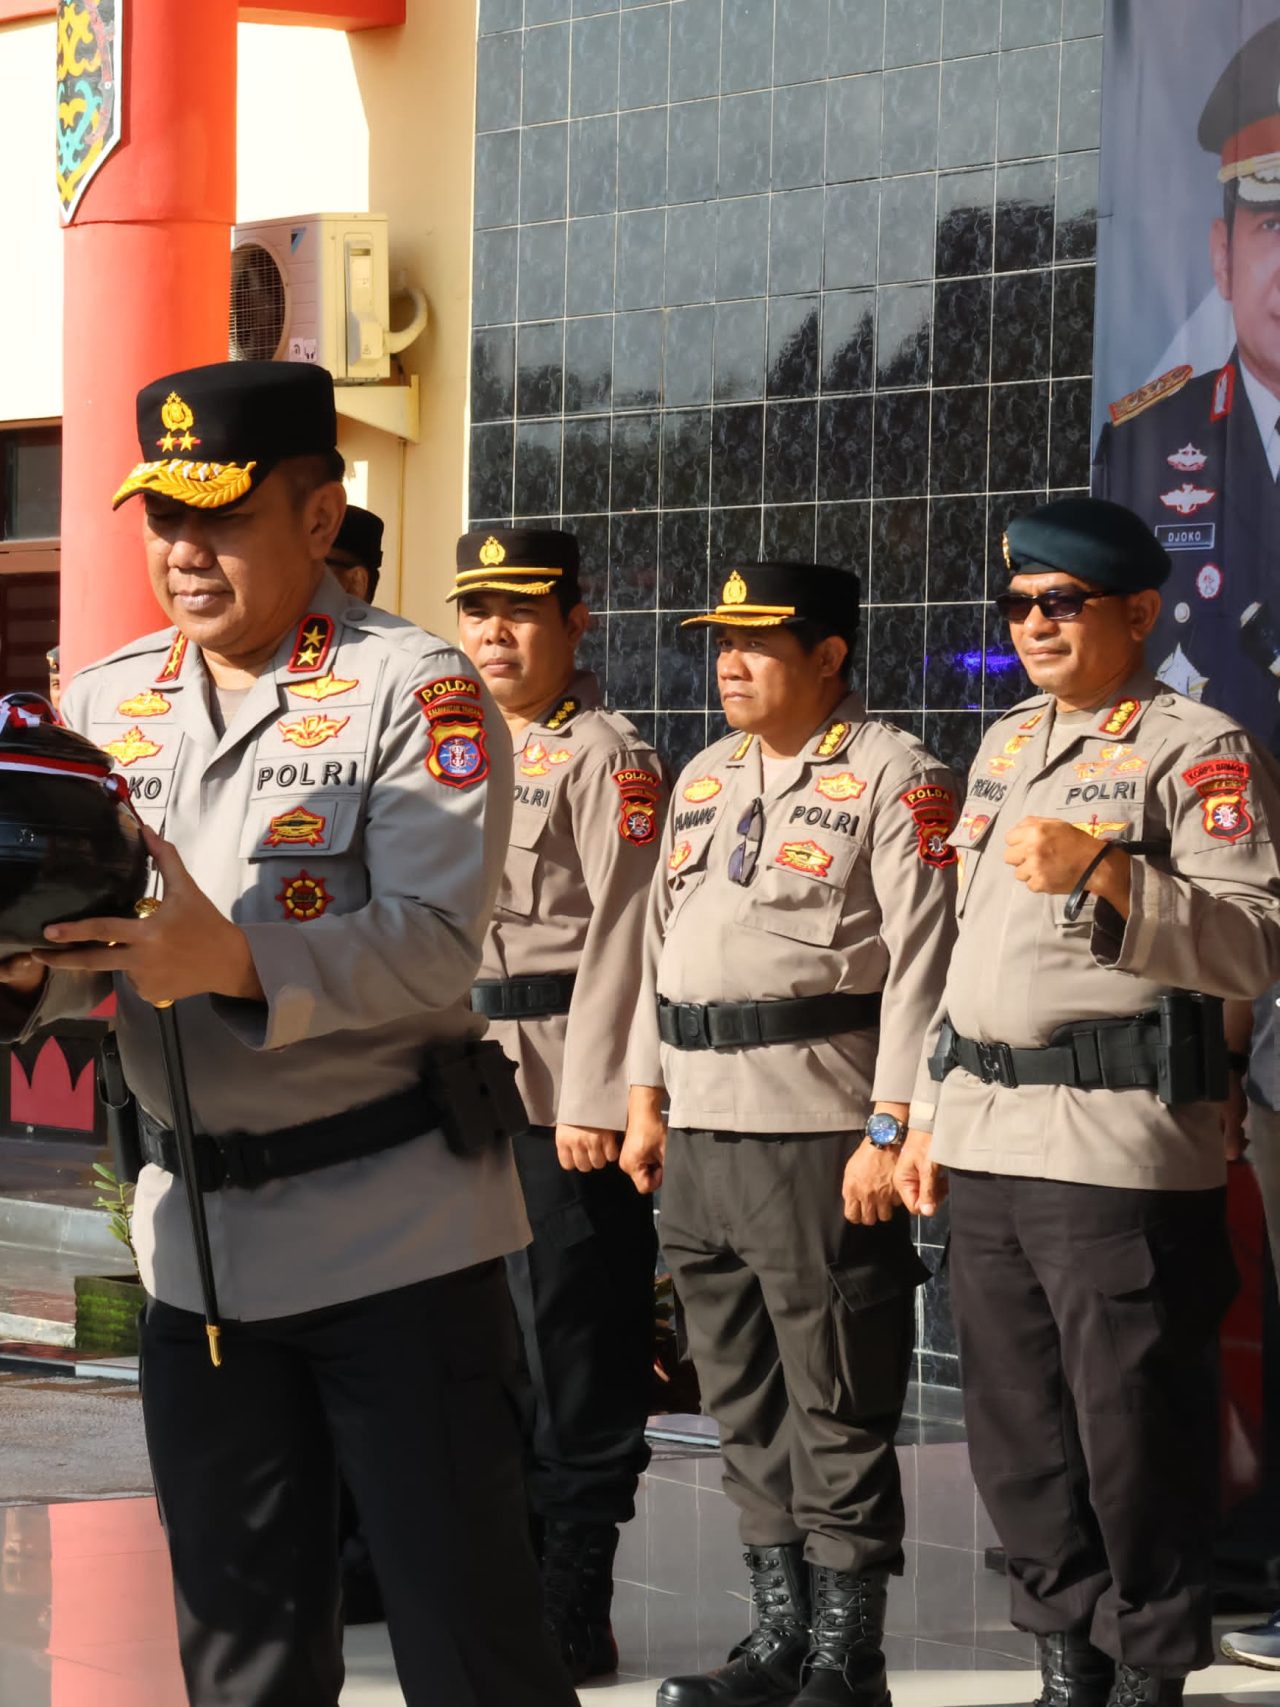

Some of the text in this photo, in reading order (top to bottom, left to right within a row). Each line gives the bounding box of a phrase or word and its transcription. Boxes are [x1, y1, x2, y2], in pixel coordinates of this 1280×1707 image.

[1168, 531, 1201, 543] DJOKO
[421, 680, 476, 702] POLDA
[257, 761, 357, 791] POLRI
[617, 772, 655, 783] POLDA
[513, 785, 551, 808] OLRI
[907, 789, 950, 803] POLDA
[1065, 782, 1135, 804] POLRI
[789, 806, 860, 837] POLRI
